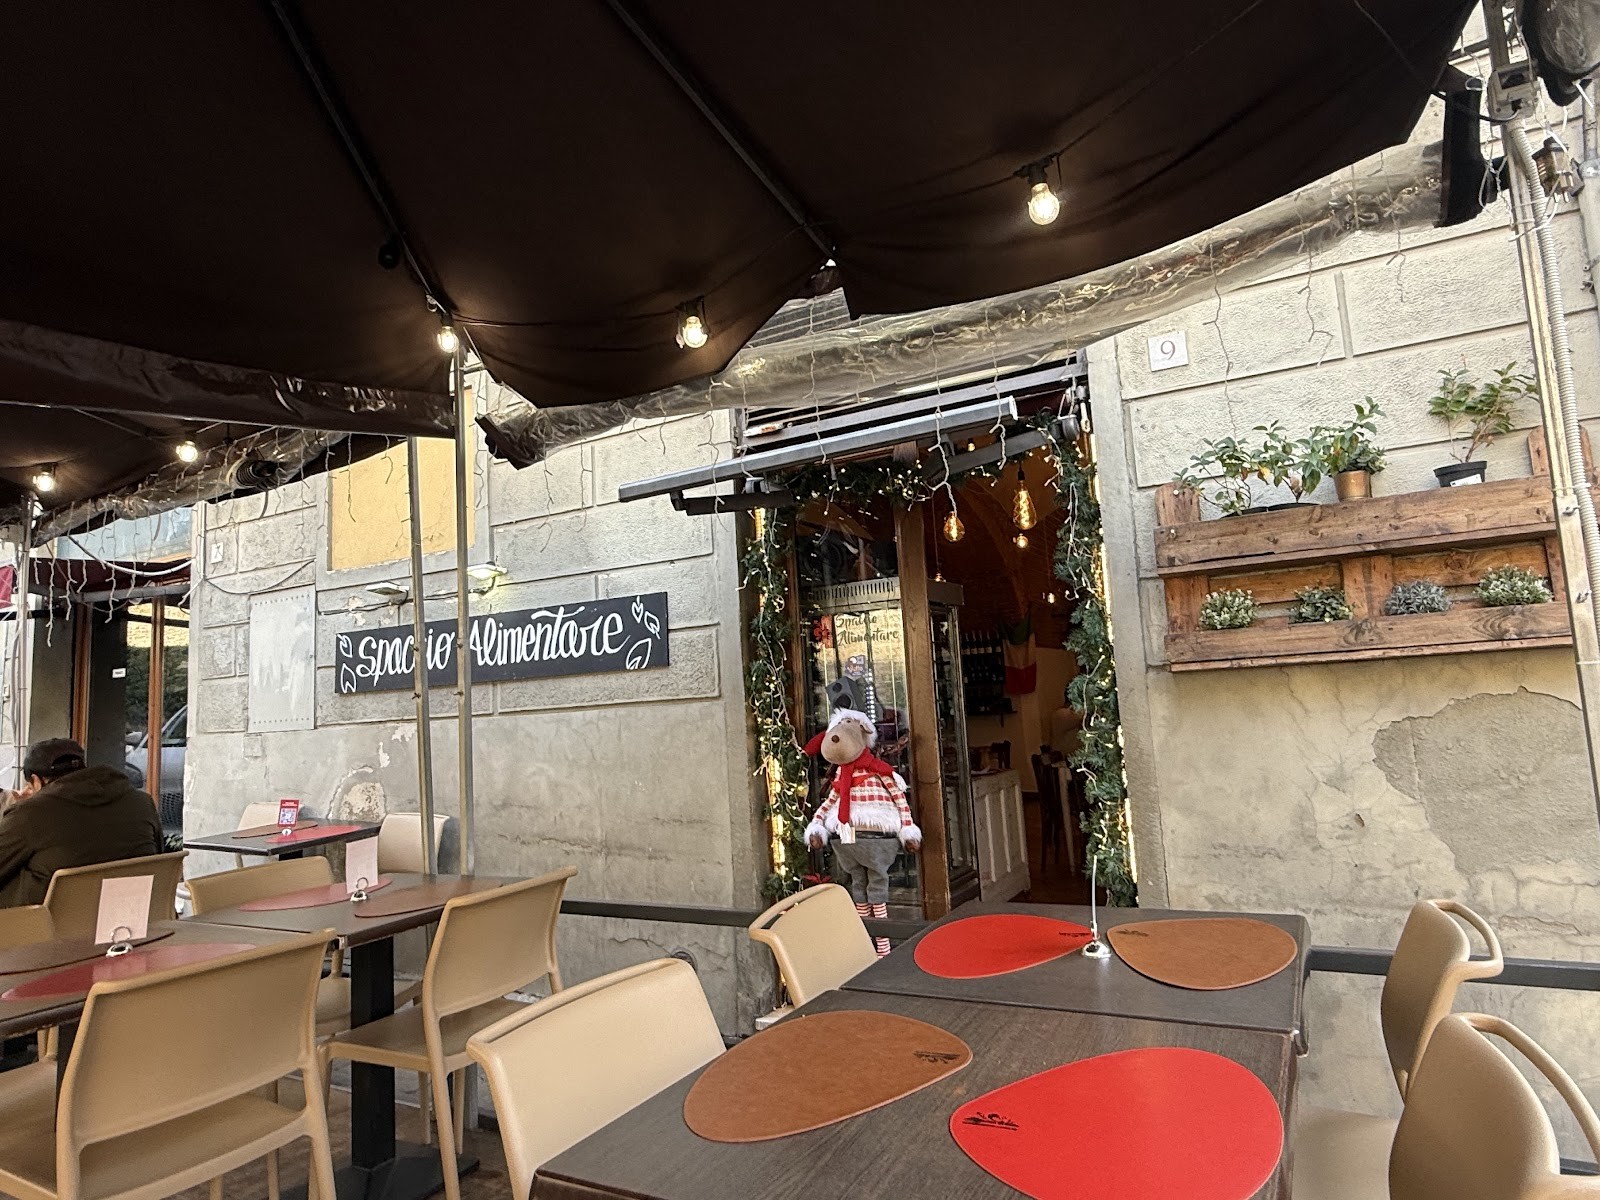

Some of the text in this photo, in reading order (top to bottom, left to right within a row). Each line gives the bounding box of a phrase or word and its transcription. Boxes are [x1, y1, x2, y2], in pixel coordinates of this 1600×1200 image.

[1160, 340, 1176, 360] 9
[356, 606, 630, 687] Spacio Alimentare
